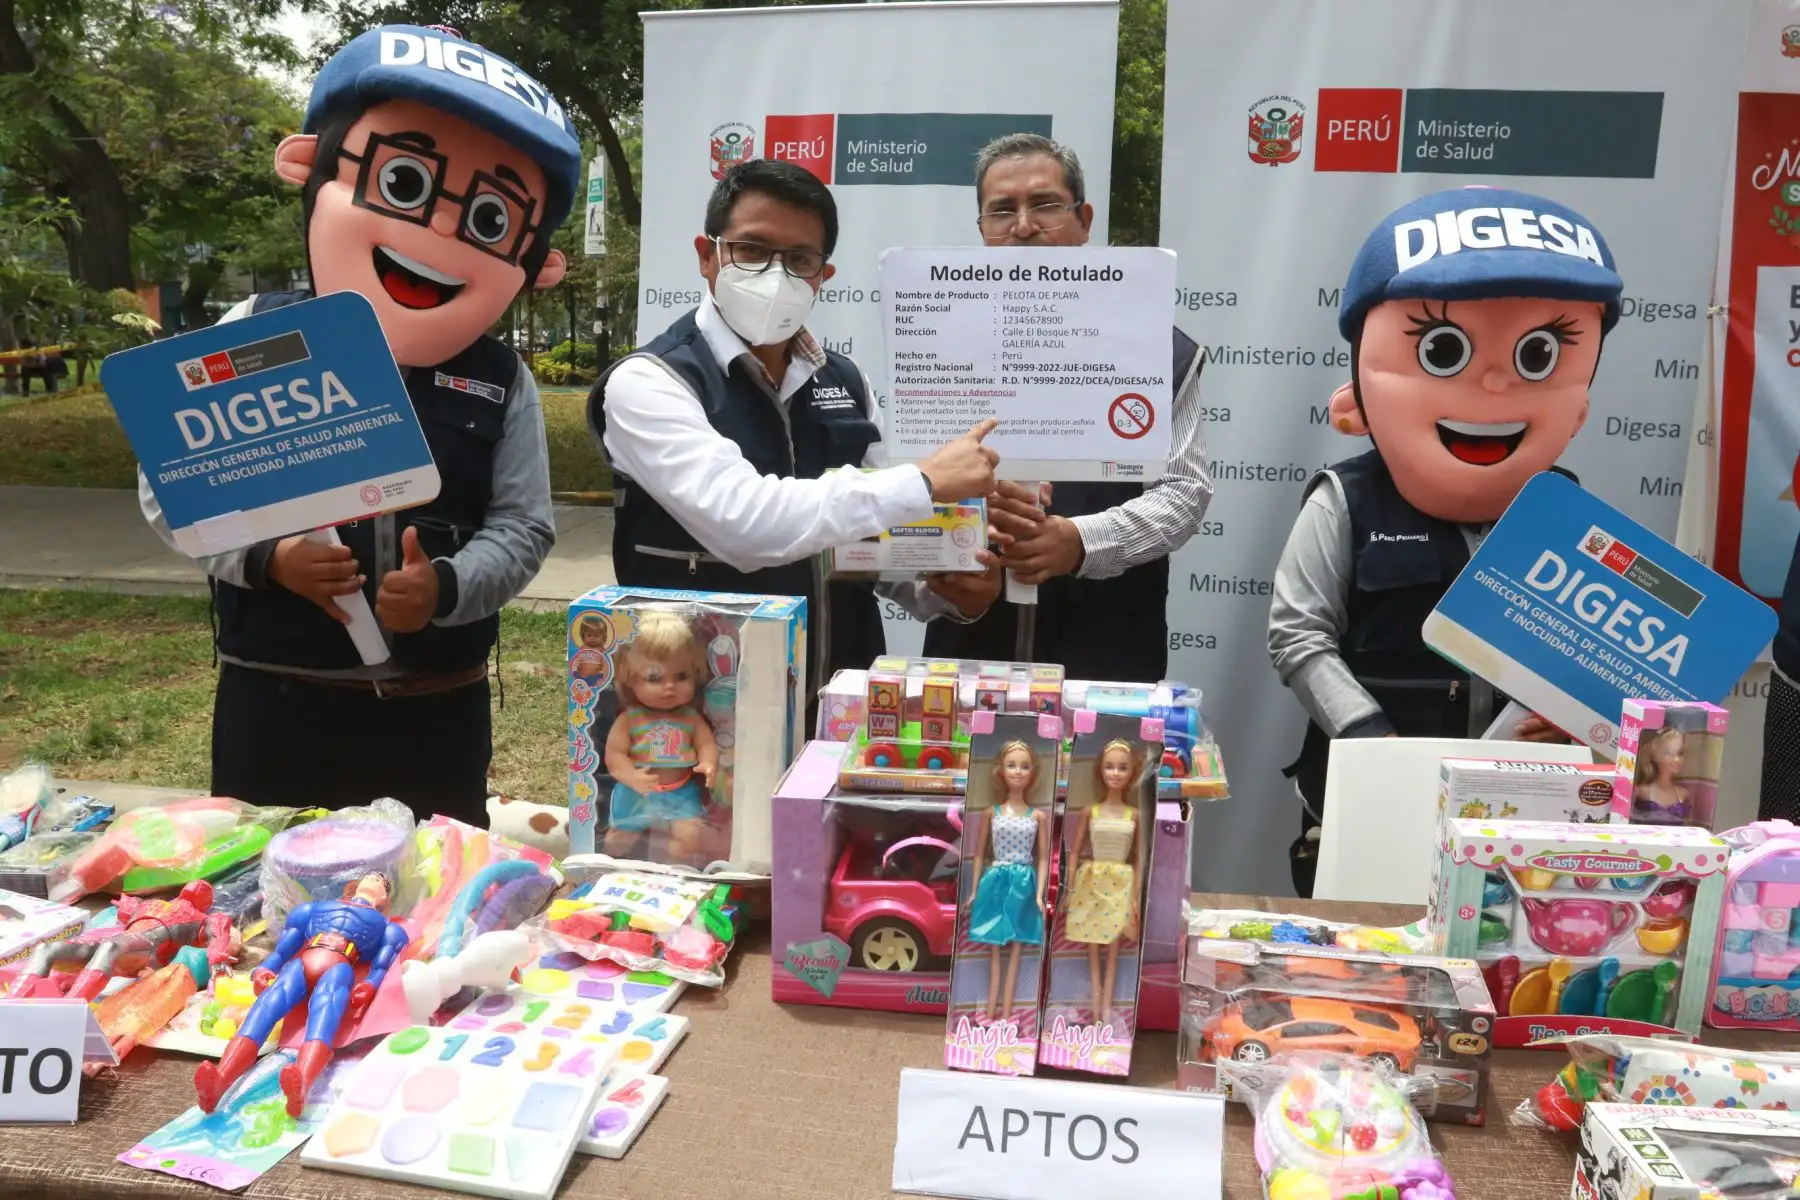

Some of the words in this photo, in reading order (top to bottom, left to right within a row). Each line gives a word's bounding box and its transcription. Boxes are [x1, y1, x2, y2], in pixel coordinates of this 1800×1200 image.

[380, 31, 566, 131] DIGESA
[1327, 114, 1392, 141] PERÚ
[1417, 119, 1511, 139] Ministerio
[773, 136, 826, 160] PERÚ
[847, 139, 928, 155] Ministerio
[1416, 141, 1438, 159] de
[1443, 142, 1494, 160] Salud
[846, 158, 866, 173] de
[869, 158, 914, 174] Salud
[1394, 207, 1605, 274] DIGESA
[930, 265, 1003, 282] Modelo
[1009, 264, 1032, 282] de
[1037, 264, 1124, 282] Rotulado
[645, 288, 702, 309] Digesa
[895, 290, 933, 300] Nombre
[935, 290, 946, 300] de
[948, 290, 990, 300] Producto
[1002, 291, 1037, 300] PELOTA
[1038, 291, 1050, 300] DE
[1053, 291, 1080, 300] PLAYA
[895, 304, 922, 313] Razón
[924, 304, 951, 313] Social
[1002, 304, 1031, 315] Happy
[1619, 297, 1697, 323] Digesa
[895, 316, 915, 325] RUC
[1002, 316, 1064, 325] 12345678900
[895, 327, 937, 337] Dirección
[1002, 327, 1024, 337] Calle
[1026, 327, 1035, 337] El
[1036, 327, 1069, 339] Bosque
[1002, 338, 1041, 349] GALERÍA
[1042, 339, 1066, 349] AZUL
[895, 351, 922, 360] Hecho
[1002, 351, 1023, 360] Perú
[1204, 345, 1316, 366] Ministerio
[1322, 346, 1350, 367] de
[208, 360, 231, 374] PERÚ
[895, 363, 931, 374] Registro
[934, 363, 973, 372] Nacional
[895, 375, 951, 385] Autorización
[1002, 376, 1020, 385] R.D.
[812, 386, 850, 399] DIGESA
[895, 388, 962, 397] Recomendaciones
[963, 390, 968, 398] y
[969, 388, 1016, 397] Advertencias
[174, 371, 359, 450] DIGESA
[901, 398, 937, 406] Mantener
[938, 398, 955, 407] lejos
[956, 398, 968, 406] del
[969, 398, 991, 407] fuego
[934, 418, 956, 427] piezas
[1011, 418, 1039, 428] podrían
[1040, 418, 1071, 428] producir
[1072, 418, 1095, 426] asfixia
[1605, 416, 1682, 442] Digesa
[900, 437, 927, 445] médico
[929, 437, 943, 445] más
[993, 428, 1027, 437] ingestión
[1028, 428, 1051, 436] acudir
[1051, 428, 1059, 436] al
[158, 458, 221, 484] DIRECCIÓN
[221, 445, 276, 469] GENERAL
[276, 439, 293, 454] DE
[294, 429, 333, 449] SALUD
[334, 410, 405, 437] AMBIENTAL
[208, 474, 218, 488] E
[218, 458, 285, 484] INOCUIDAD
[287, 436, 368, 467] ALIMENTARIA
[1608, 549, 1629, 566] PERÚ
[1524, 549, 1689, 677] DIGESA
[1473, 570, 1530, 611] DIRECCIÓN
[1531, 607, 1580, 645] GENERAL
[1580, 638, 1599, 655] DE
[1595, 648, 1634, 677] SALUD
[1504, 607, 1513, 618] E
[1512, 613, 1576, 658] INOCUIDAD
[1573, 653, 1649, 701] ALIMENTARIA
[1544, 856, 1580, 872] Tasty
[1584, 857, 1643, 872] Gourmet
[1460, 908, 1473, 918] 3+
[790, 952, 841, 971] Beauty
[906, 984, 950, 1005] Auto
[956, 1015, 1019, 1058] Angie
[1051, 1014, 1114, 1059] Angie
[1604, 1105, 1680, 1116] SUPER
[1684, 1109, 1757, 1119] SPEED
[957, 1105, 1140, 1164] APTOS
